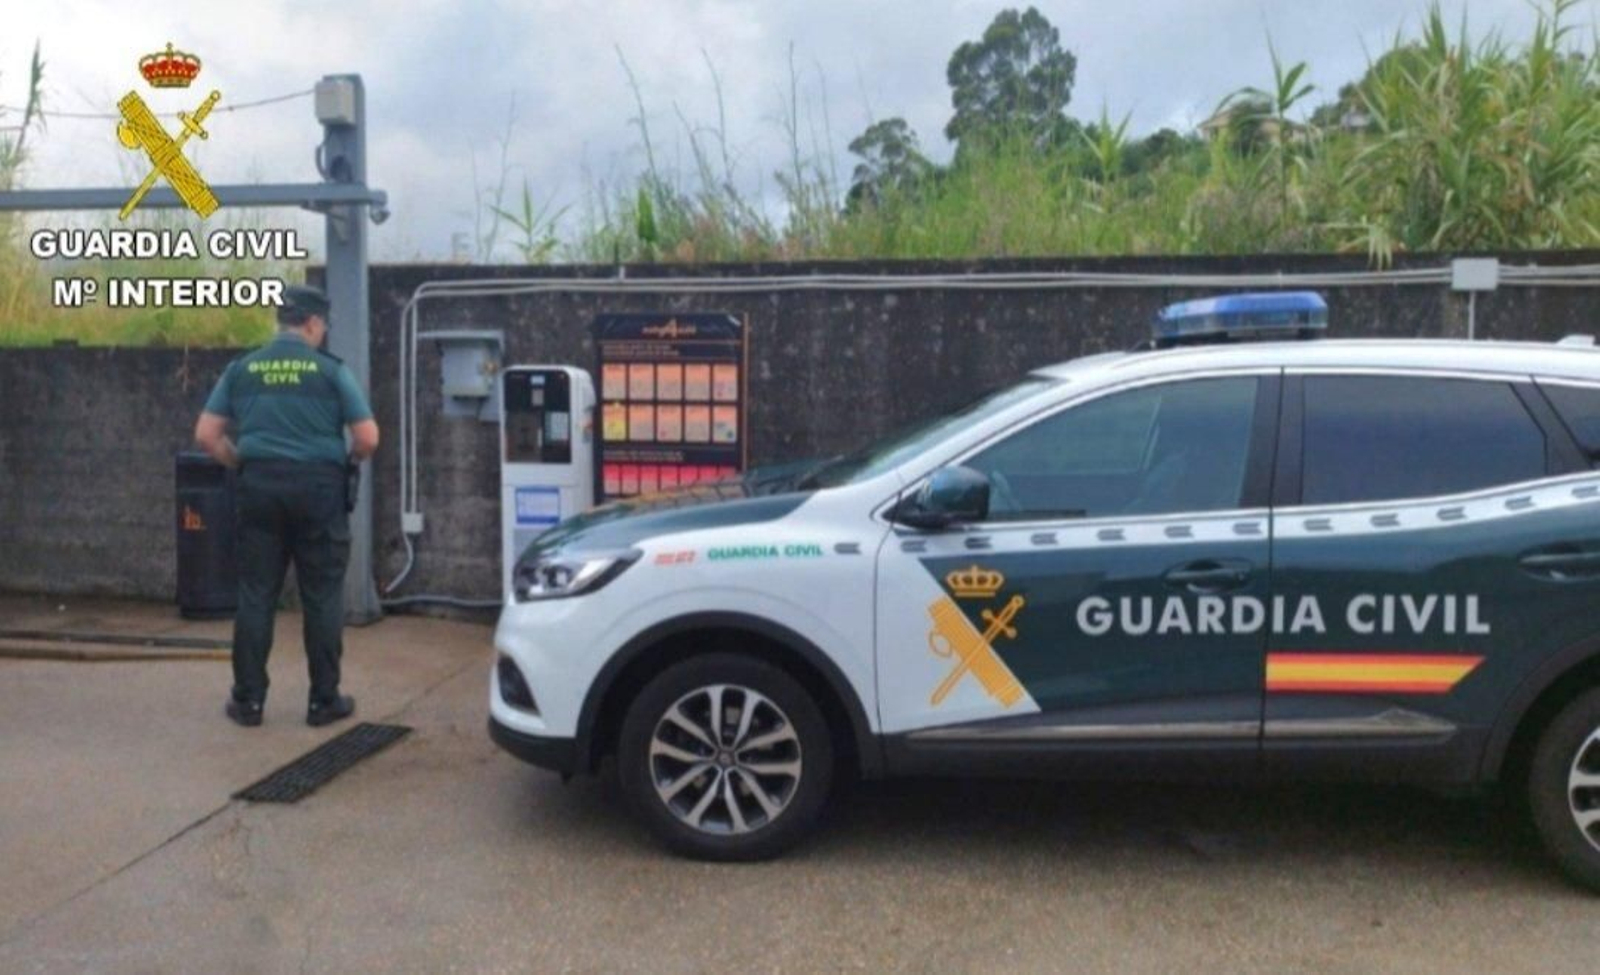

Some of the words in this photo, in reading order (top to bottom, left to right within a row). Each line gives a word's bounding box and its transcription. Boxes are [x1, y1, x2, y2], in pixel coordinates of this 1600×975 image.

[248, 359, 318, 373] GUARDIA
[263, 372, 302, 385] CIVIL
[707, 545, 779, 561] GUARDIA
[784, 543, 824, 557] CIVIL
[1076, 595, 1326, 636] GUARDIA
[1346, 594, 1491, 635] CIVIL
